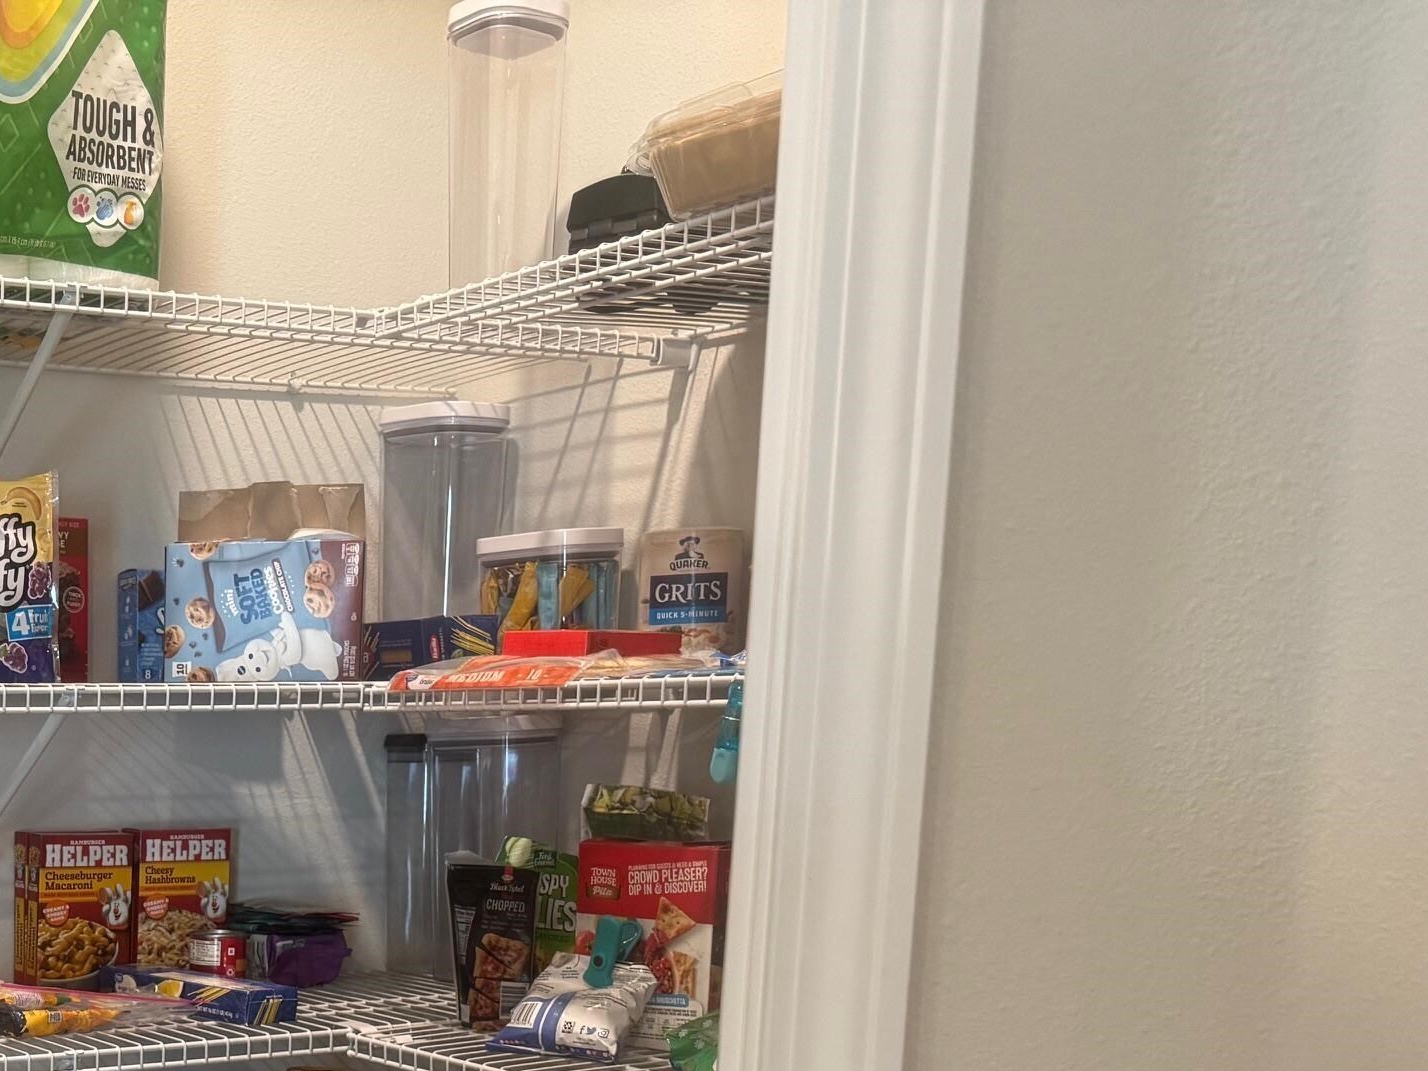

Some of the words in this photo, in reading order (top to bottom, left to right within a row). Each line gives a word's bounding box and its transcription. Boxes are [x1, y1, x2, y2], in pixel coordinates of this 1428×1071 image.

[71, 90, 137, 143] TOUGH
[142, 107, 156, 148] &
[65, 133, 154, 176] ABSORBENT
[72, 166, 86, 181] FOR
[86, 169, 121, 188] EVERYDAY
[120, 174, 147, 191] MESSES
[669, 558, 709, 571] QUAKER
[233, 573, 260, 625] SOFT
[250, 568, 273, 620] BAKED
[654, 580, 722, 604] GRITS
[11, 610, 31, 636] 4
[656, 610, 679, 620] QUICK
[176, 663, 185, 675] 10
[445, 670, 505, 683] MEDIUM
[45, 844, 128, 867] HELPER
[145, 838, 226, 861] HELPER
[44, 871, 114, 882] Cheeseburger
[145, 866, 175, 876] Cheesy
[590, 866, 616, 877] TOWN
[628, 869, 660, 884] CROWD
[661, 867, 708, 883] PLEASER?
[44, 881, 93, 891] Macaroni
[145, 875, 196, 884] Hashbrowns
[538, 873, 570, 898] SPY
[590, 876, 617, 887] HOUSE
[628, 884, 642, 896] DIP
[644, 884, 652, 895] IN
[654, 882, 662, 895] &
[664, 880, 707, 894] DISCOVER!
[485, 898, 525, 912] CHOPPED
